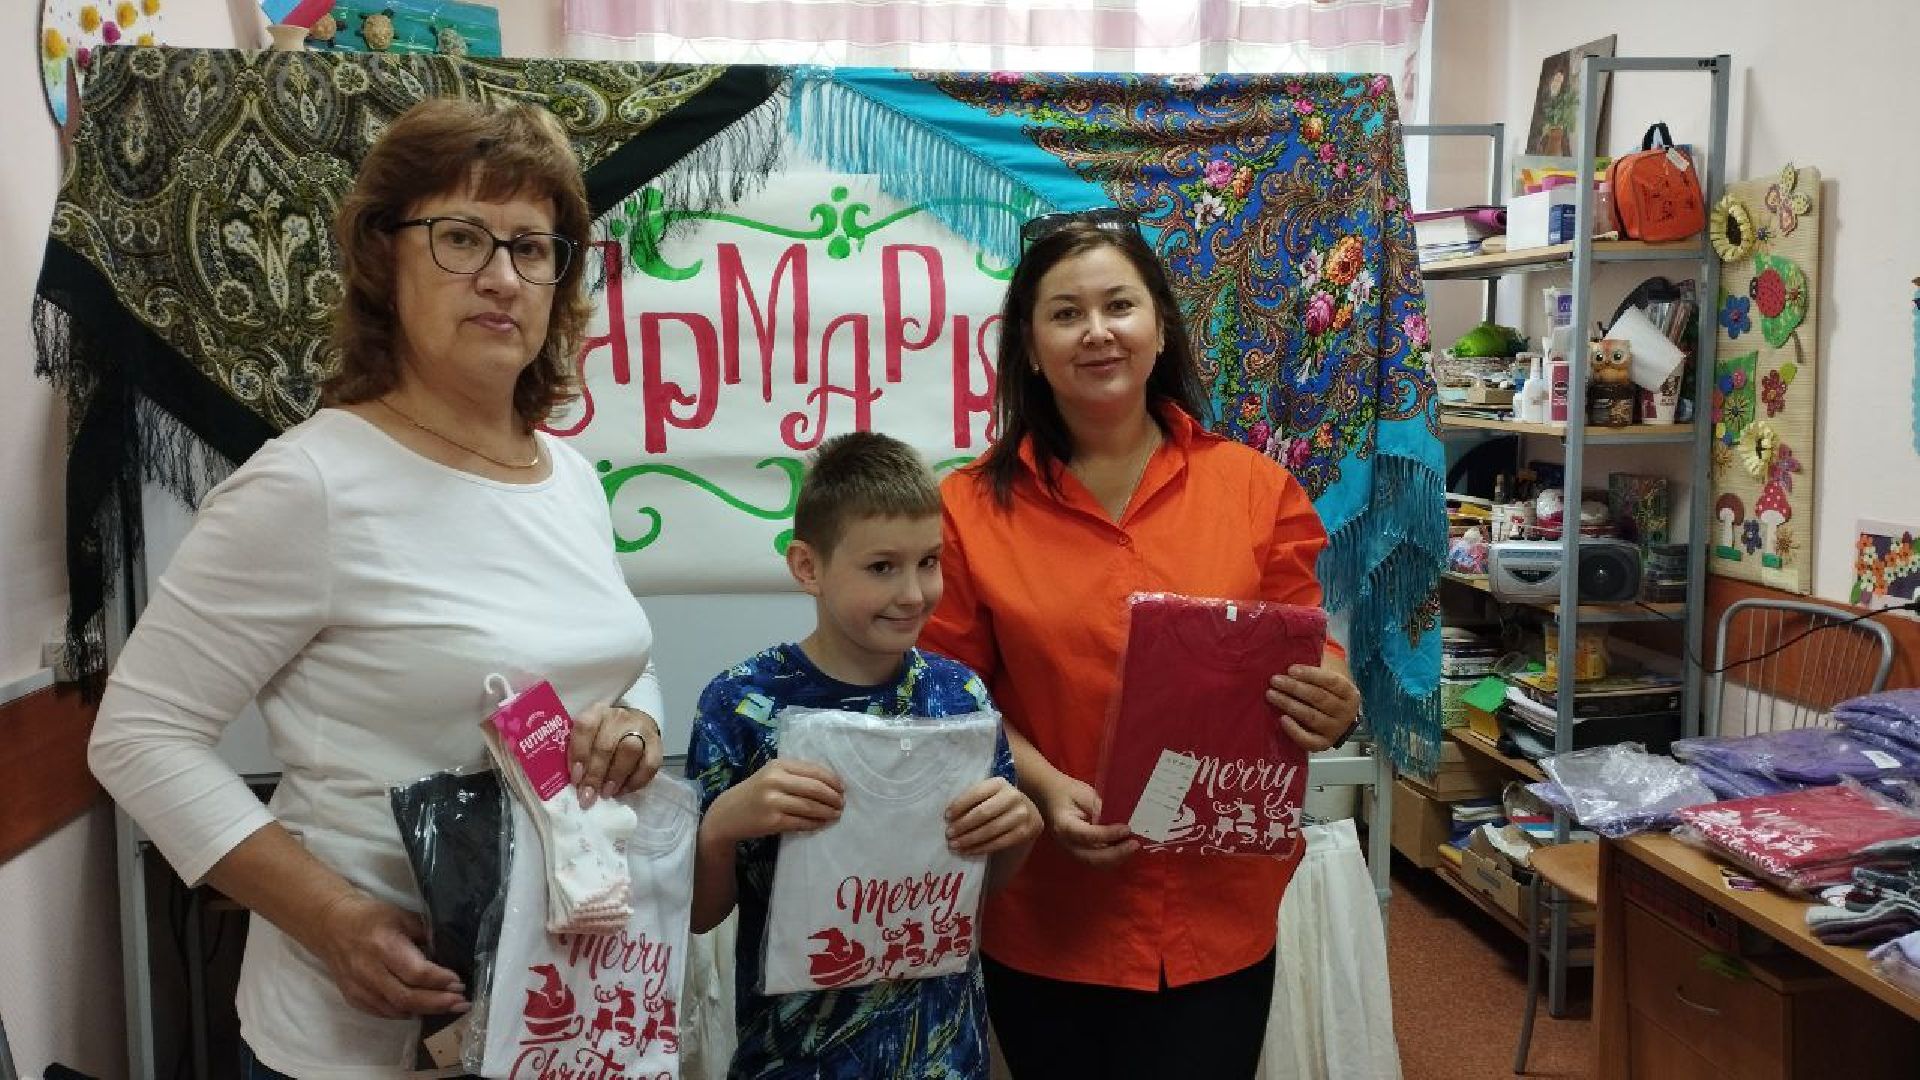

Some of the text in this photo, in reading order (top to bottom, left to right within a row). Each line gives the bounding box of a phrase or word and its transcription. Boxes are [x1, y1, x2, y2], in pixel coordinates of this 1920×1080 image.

[534, 239, 1003, 454] ЯРМАРК
[1180, 751, 1297, 808] Merry
[836, 871, 964, 927] Merry
[558, 929, 672, 1001] Merry
